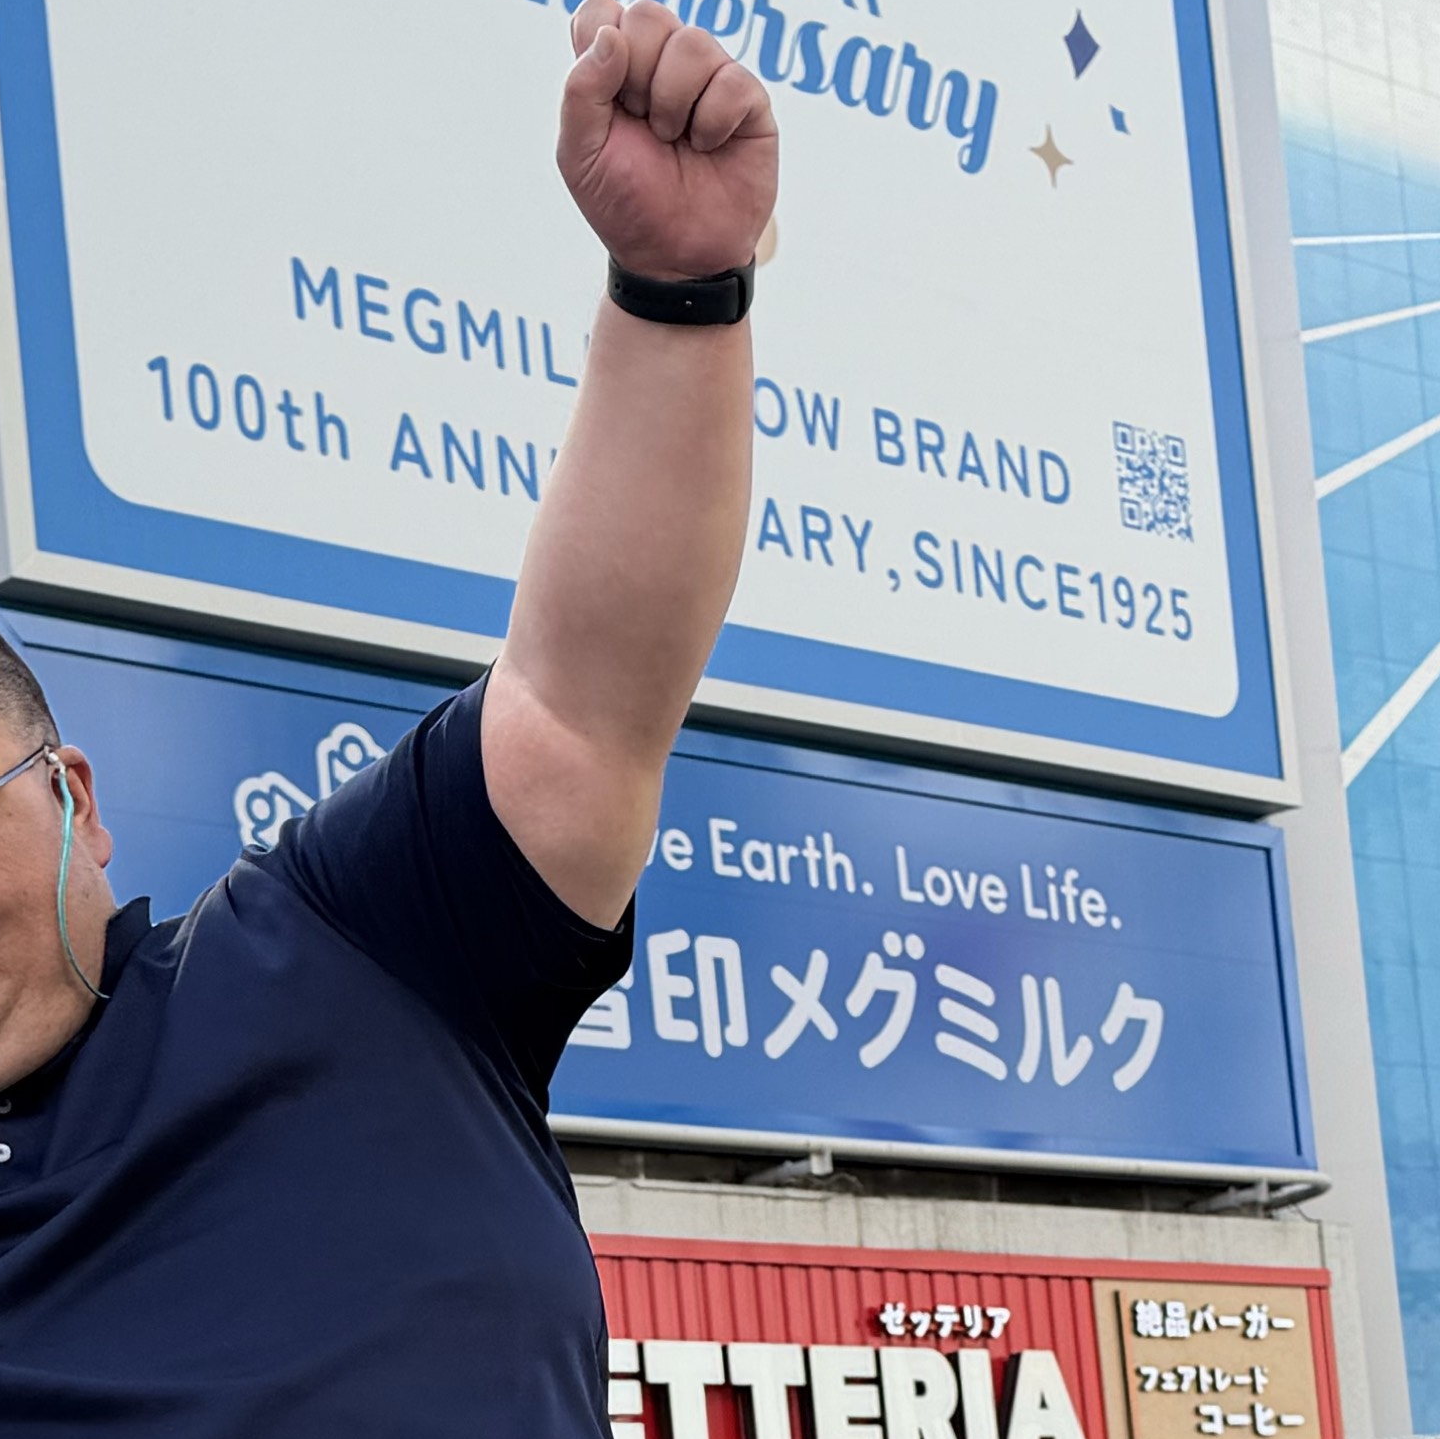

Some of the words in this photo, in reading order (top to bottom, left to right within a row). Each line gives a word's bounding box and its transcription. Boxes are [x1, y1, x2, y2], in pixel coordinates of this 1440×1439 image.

[147, 354, 350, 462] 100th
[290, 256, 591, 389] MEGMIL
[873, 406, 1072, 506] BRAND
[708, 817, 874, 897] Earth.
[895, 846, 1008, 913] Love
[1020, 863, 1122, 930] Life.
[878, 1301, 1013, 1340] ゼッテリア
[1133, 1298, 1295, 1340] 絶品バーガー
[1196, 1402, 1306, 1437] コーヒー
